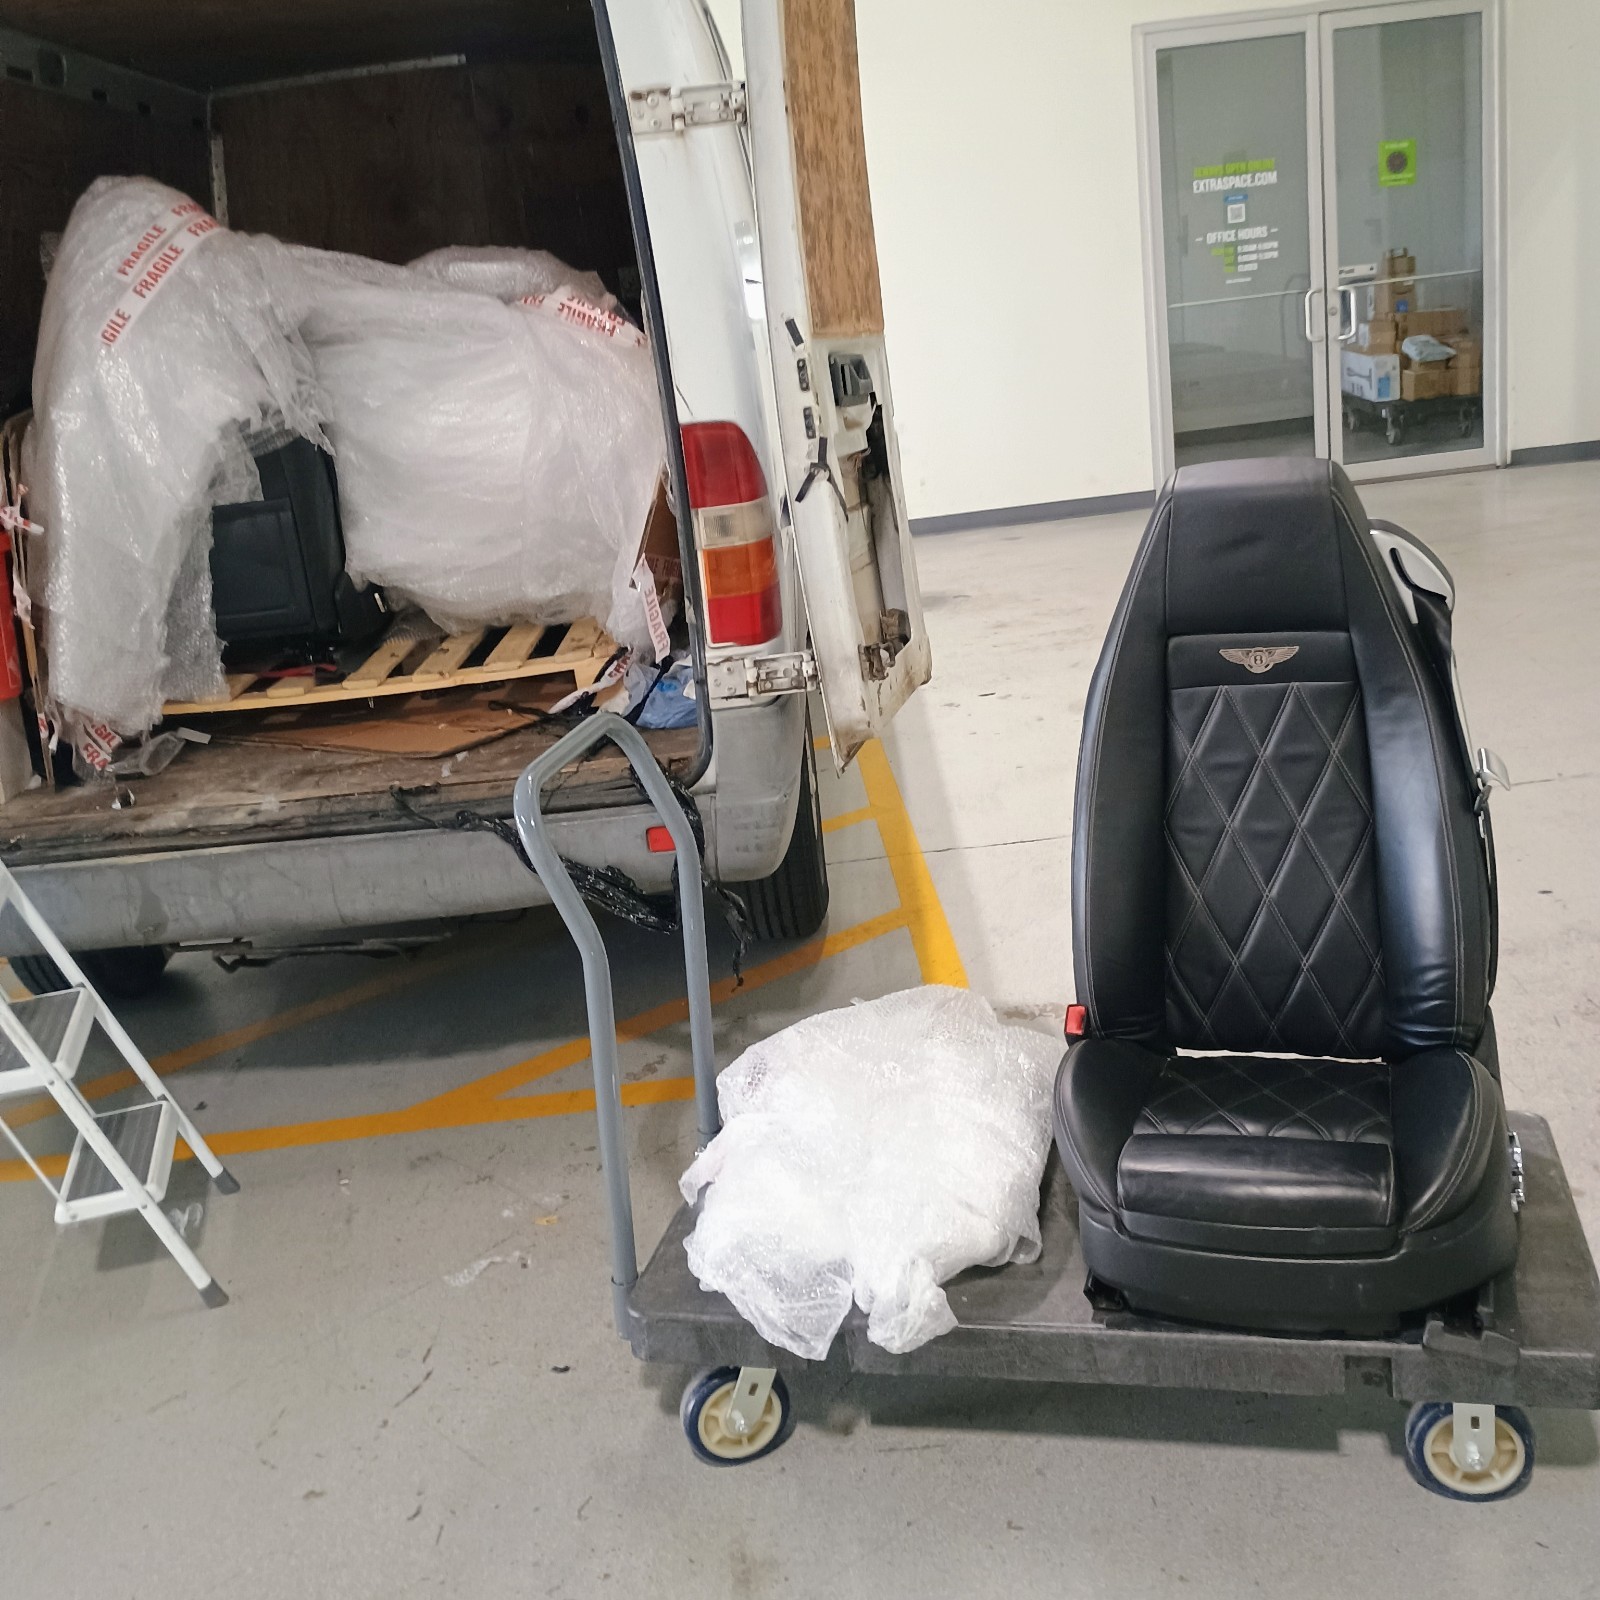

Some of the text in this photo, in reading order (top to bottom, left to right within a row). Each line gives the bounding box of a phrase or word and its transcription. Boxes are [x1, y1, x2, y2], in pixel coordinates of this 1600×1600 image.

[1192, 170, 1277, 193] EXTRASPACE.COM
[1206, 226, 1268, 244] OFFICE HOURS
[117, 223, 167, 276] FRAGILE
[132, 243, 184, 299] FRAGILE
[91, 724, 117, 748] GIL
